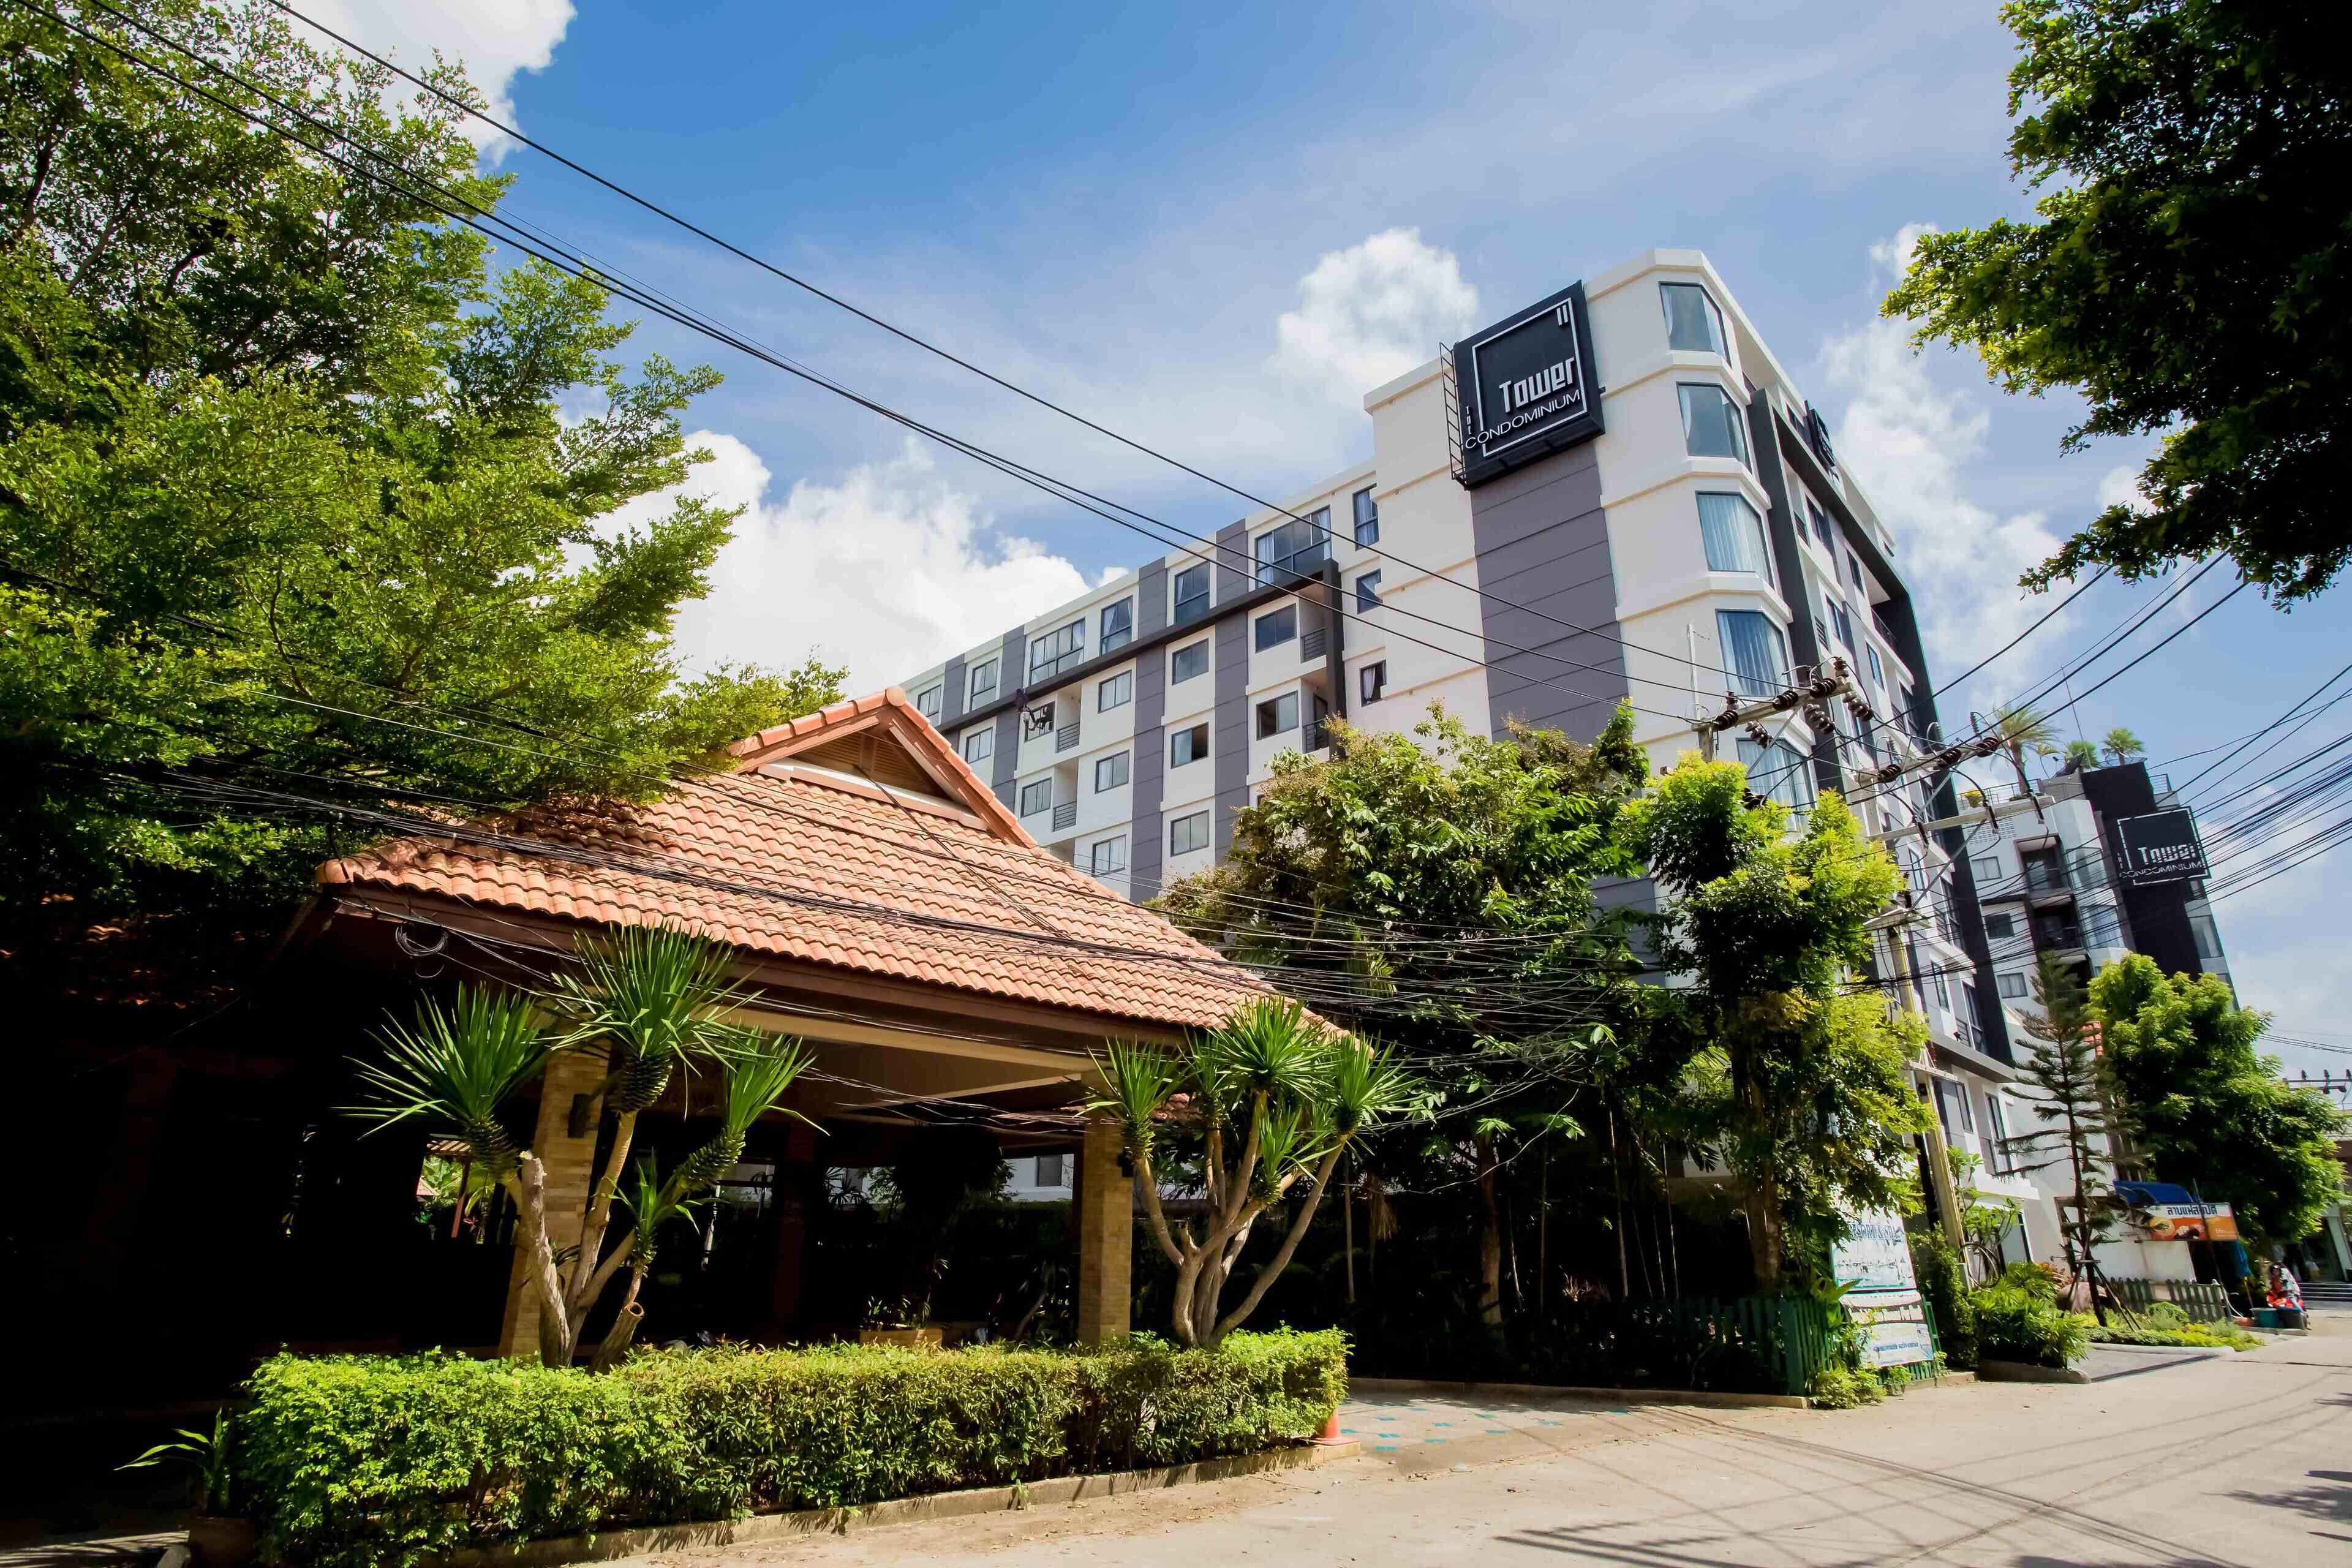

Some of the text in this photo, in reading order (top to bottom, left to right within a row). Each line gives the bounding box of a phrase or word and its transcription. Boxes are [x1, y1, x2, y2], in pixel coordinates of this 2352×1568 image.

[1499, 357, 1575, 413] Tower
[1465, 390, 1580, 449] CONDOMINIUM
[2119, 861, 2203, 878] CONDOMINIUM
